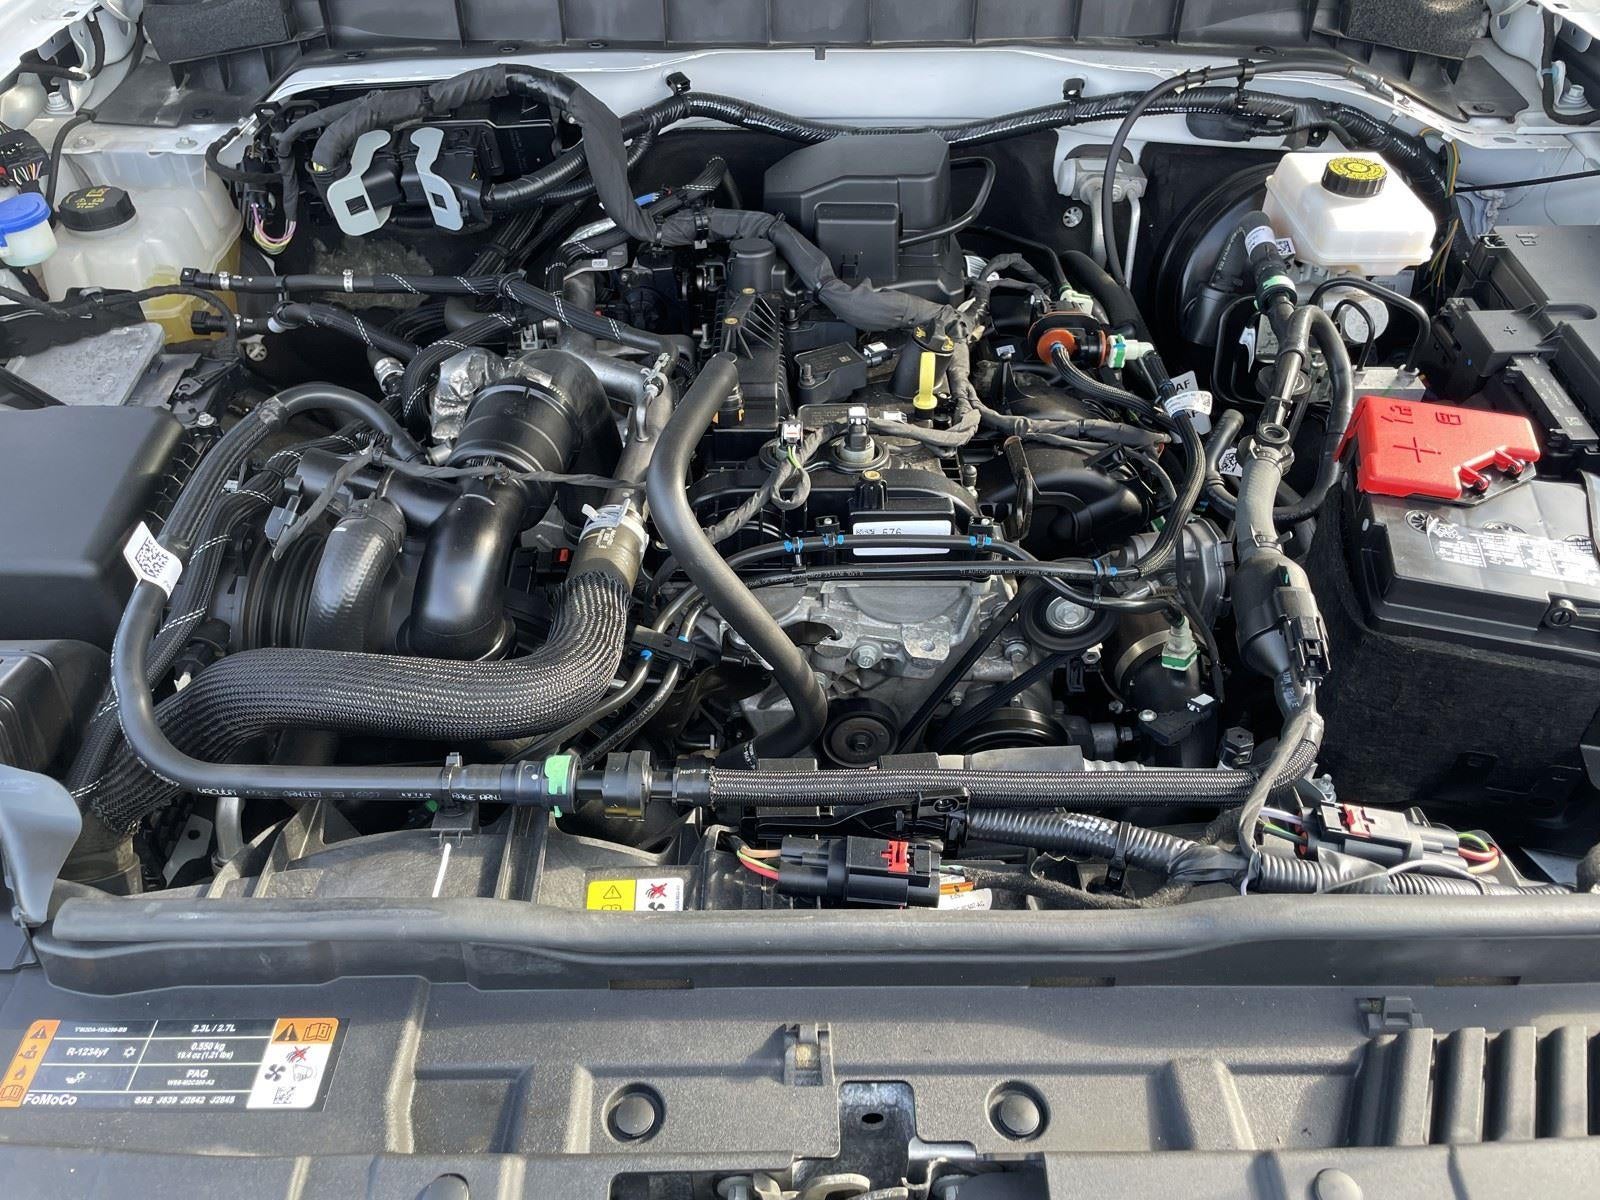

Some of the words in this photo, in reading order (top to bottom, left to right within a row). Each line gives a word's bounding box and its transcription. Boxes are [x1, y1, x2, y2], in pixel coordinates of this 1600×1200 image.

[191, 1024, 210, 1032] 2.3L
[217, 1024, 236, 1032] 2.7L
[190, 1041, 214, 1051] 0.550
[214, 1041, 226, 1052] kg
[66, 1047, 110, 1058] R-1234yf
[186, 1069, 209, 1078] PAG
[23, 1094, 78, 1105] FoMoCo
[134, 1096, 155, 1105] SAE
